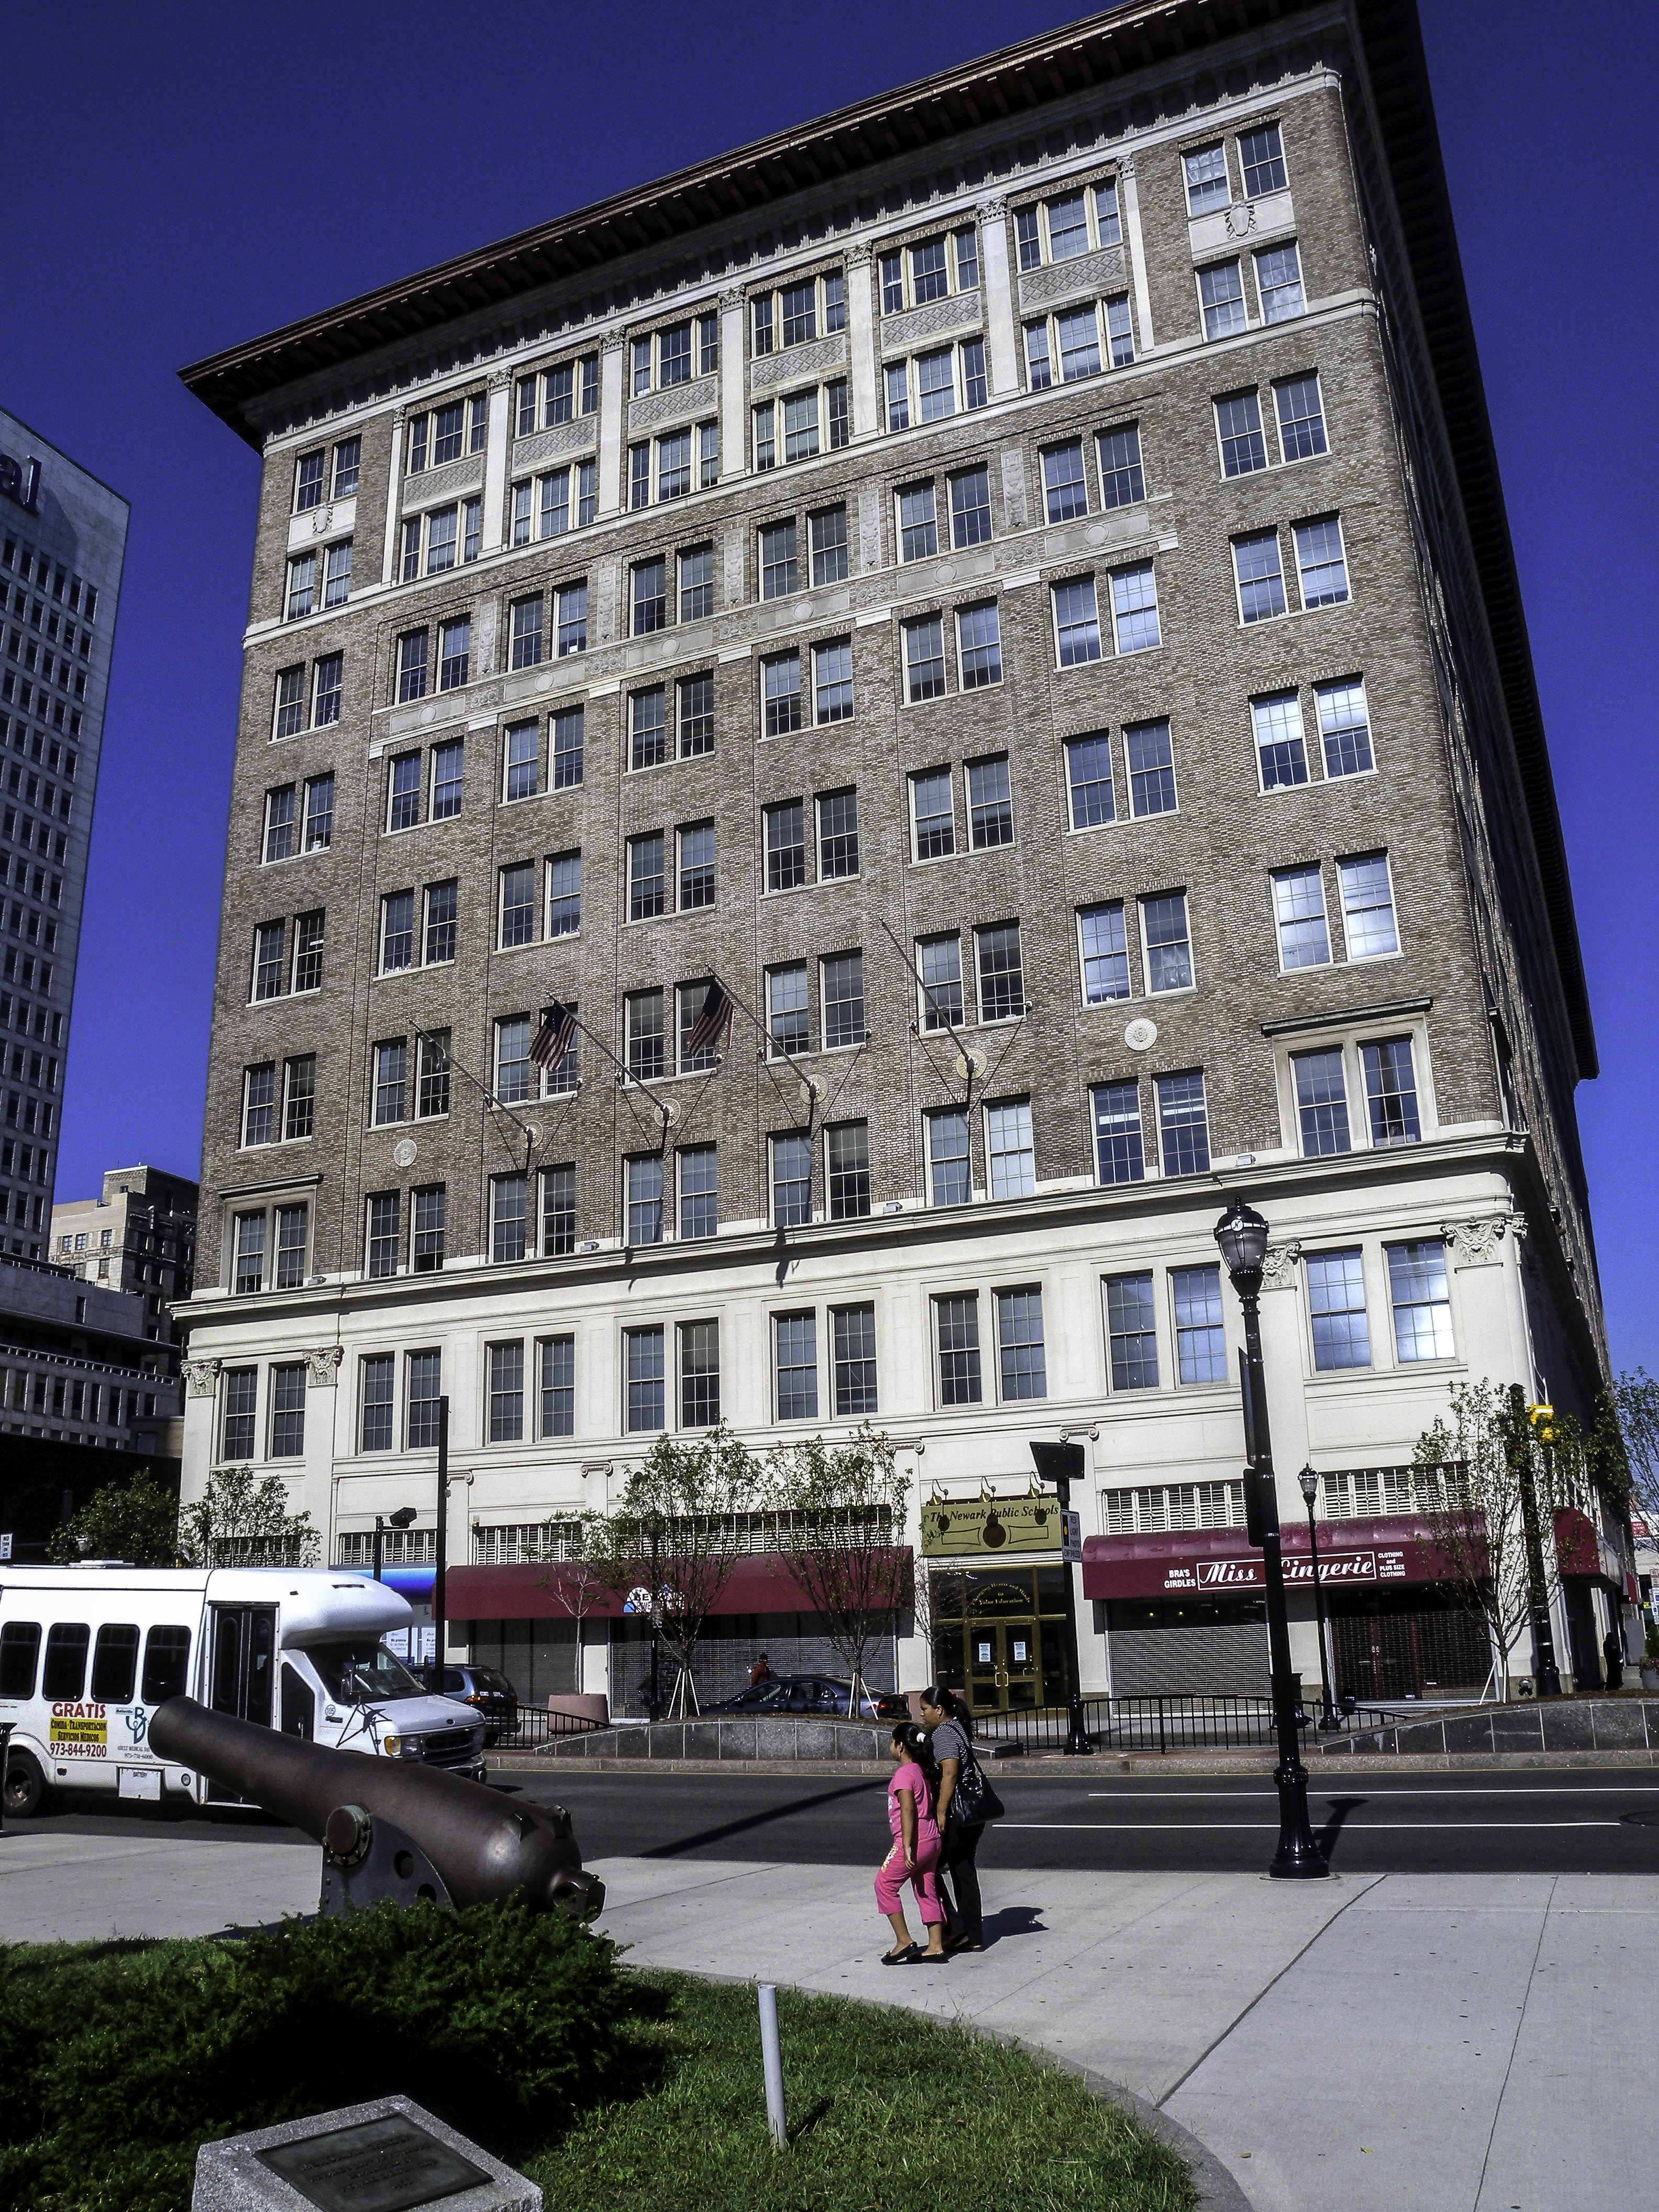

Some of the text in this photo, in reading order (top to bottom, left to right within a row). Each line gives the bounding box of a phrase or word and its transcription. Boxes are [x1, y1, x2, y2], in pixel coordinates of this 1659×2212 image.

[949, 1509, 987, 1521] Newark
[1021, 1505, 1058, 1517] Schols
[1168, 1569, 1190, 1578] BRA'S
[1200, 1563, 1257, 1584] Miss
[1164, 1578, 1197, 1589] GIRDLES
[52, 1702, 106, 1719] GRATIS
[50, 1742, 107, 1757] 973-844-9200
